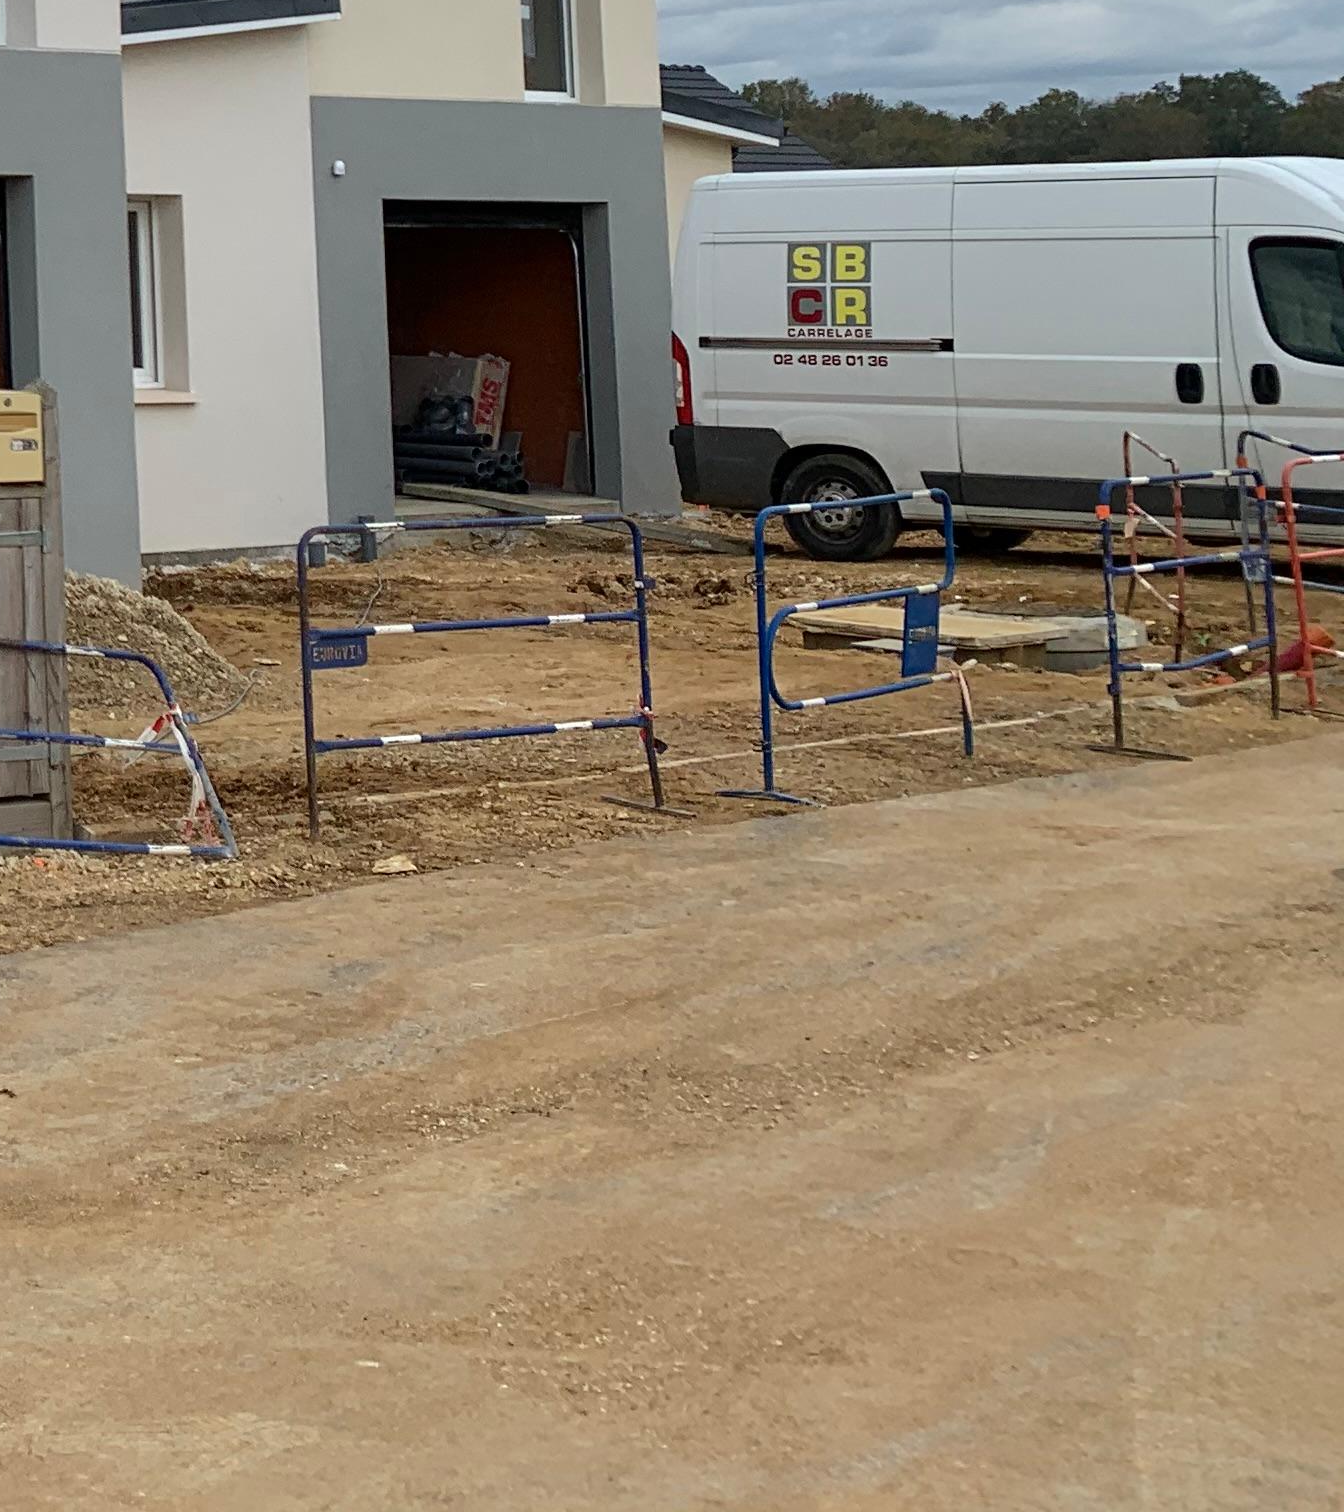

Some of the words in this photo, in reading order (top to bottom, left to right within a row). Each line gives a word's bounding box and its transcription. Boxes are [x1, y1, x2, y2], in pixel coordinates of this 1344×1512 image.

[787, 328, 873, 339] CARRELAGE
[773, 354, 794, 365] 02
[797, 354, 818, 366] 48
[821, 355, 842, 366] 26
[846, 355, 864, 366] 01
[867, 355, 889, 367] 36
